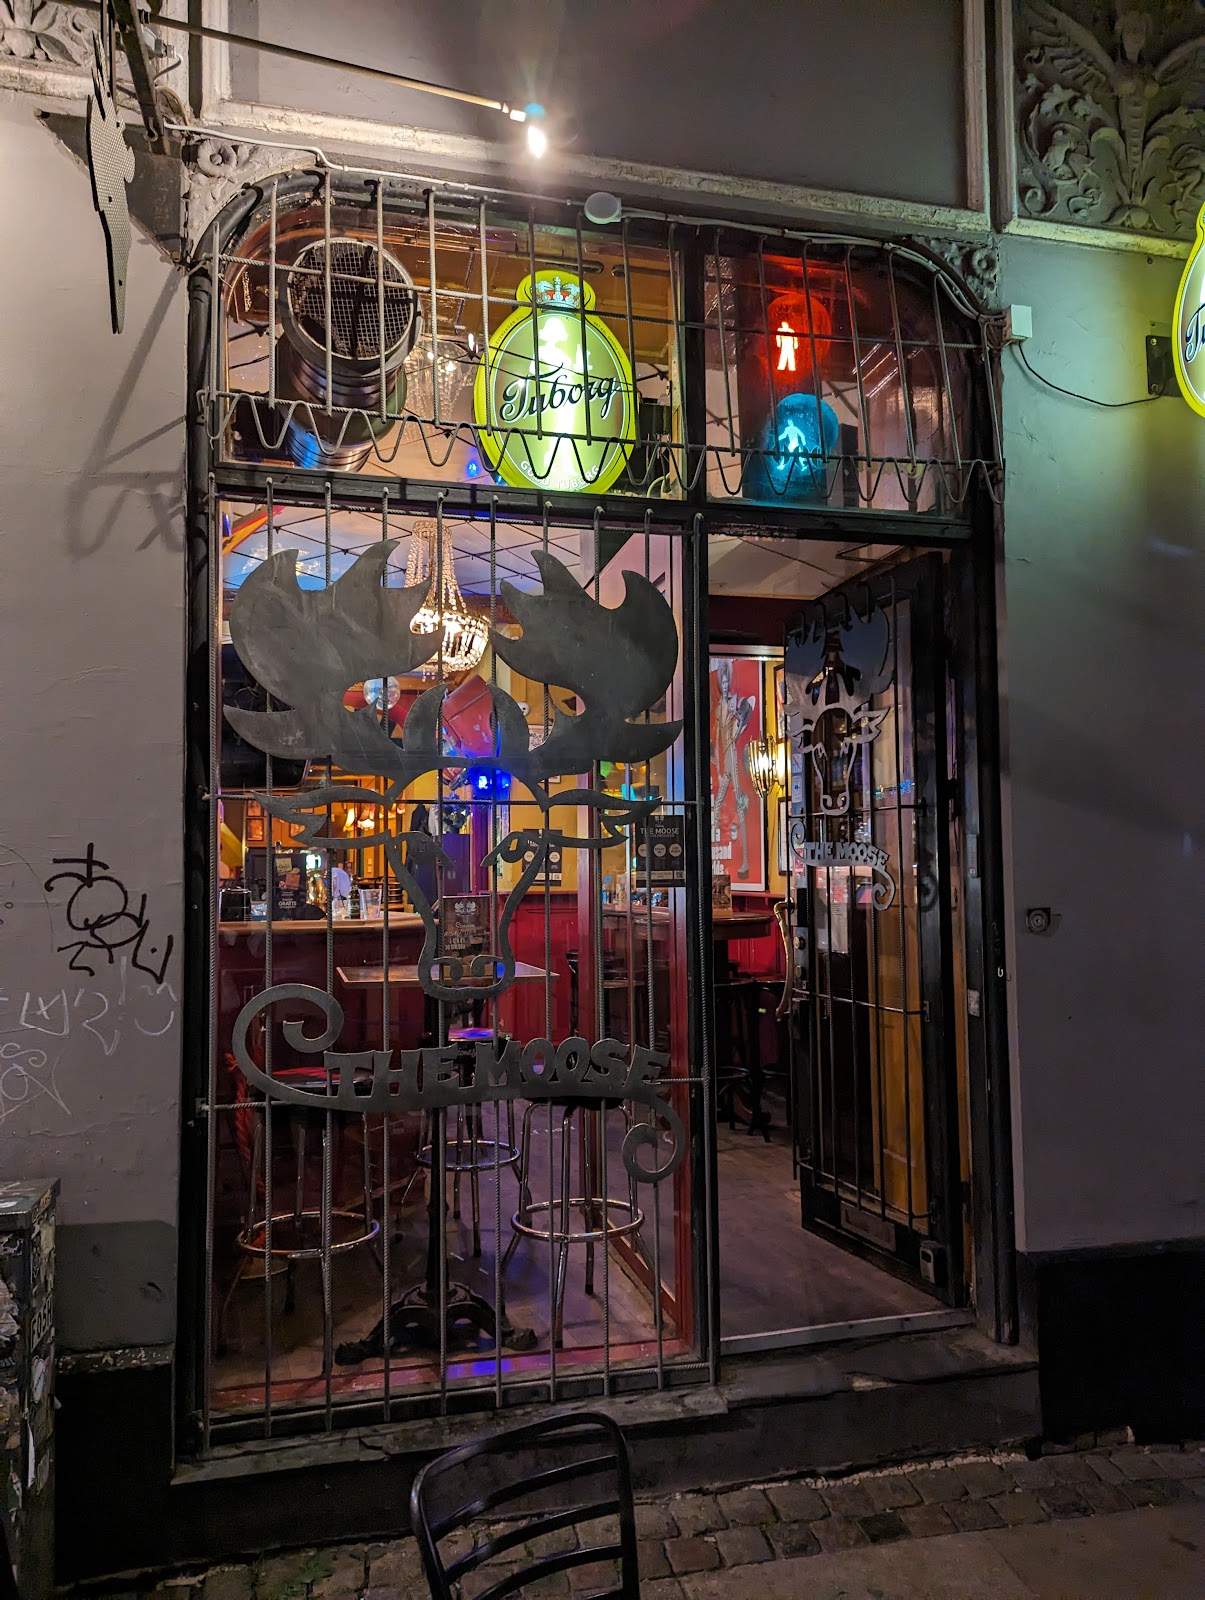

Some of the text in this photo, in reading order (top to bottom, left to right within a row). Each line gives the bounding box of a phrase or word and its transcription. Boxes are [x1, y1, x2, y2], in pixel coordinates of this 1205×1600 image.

[500, 361, 621, 422] Tuborg
[655, 827, 679, 835] MOOSE
[804, 841, 890, 869] THE MOOSE
[323, 1037, 671, 1099] THE MOOSE
